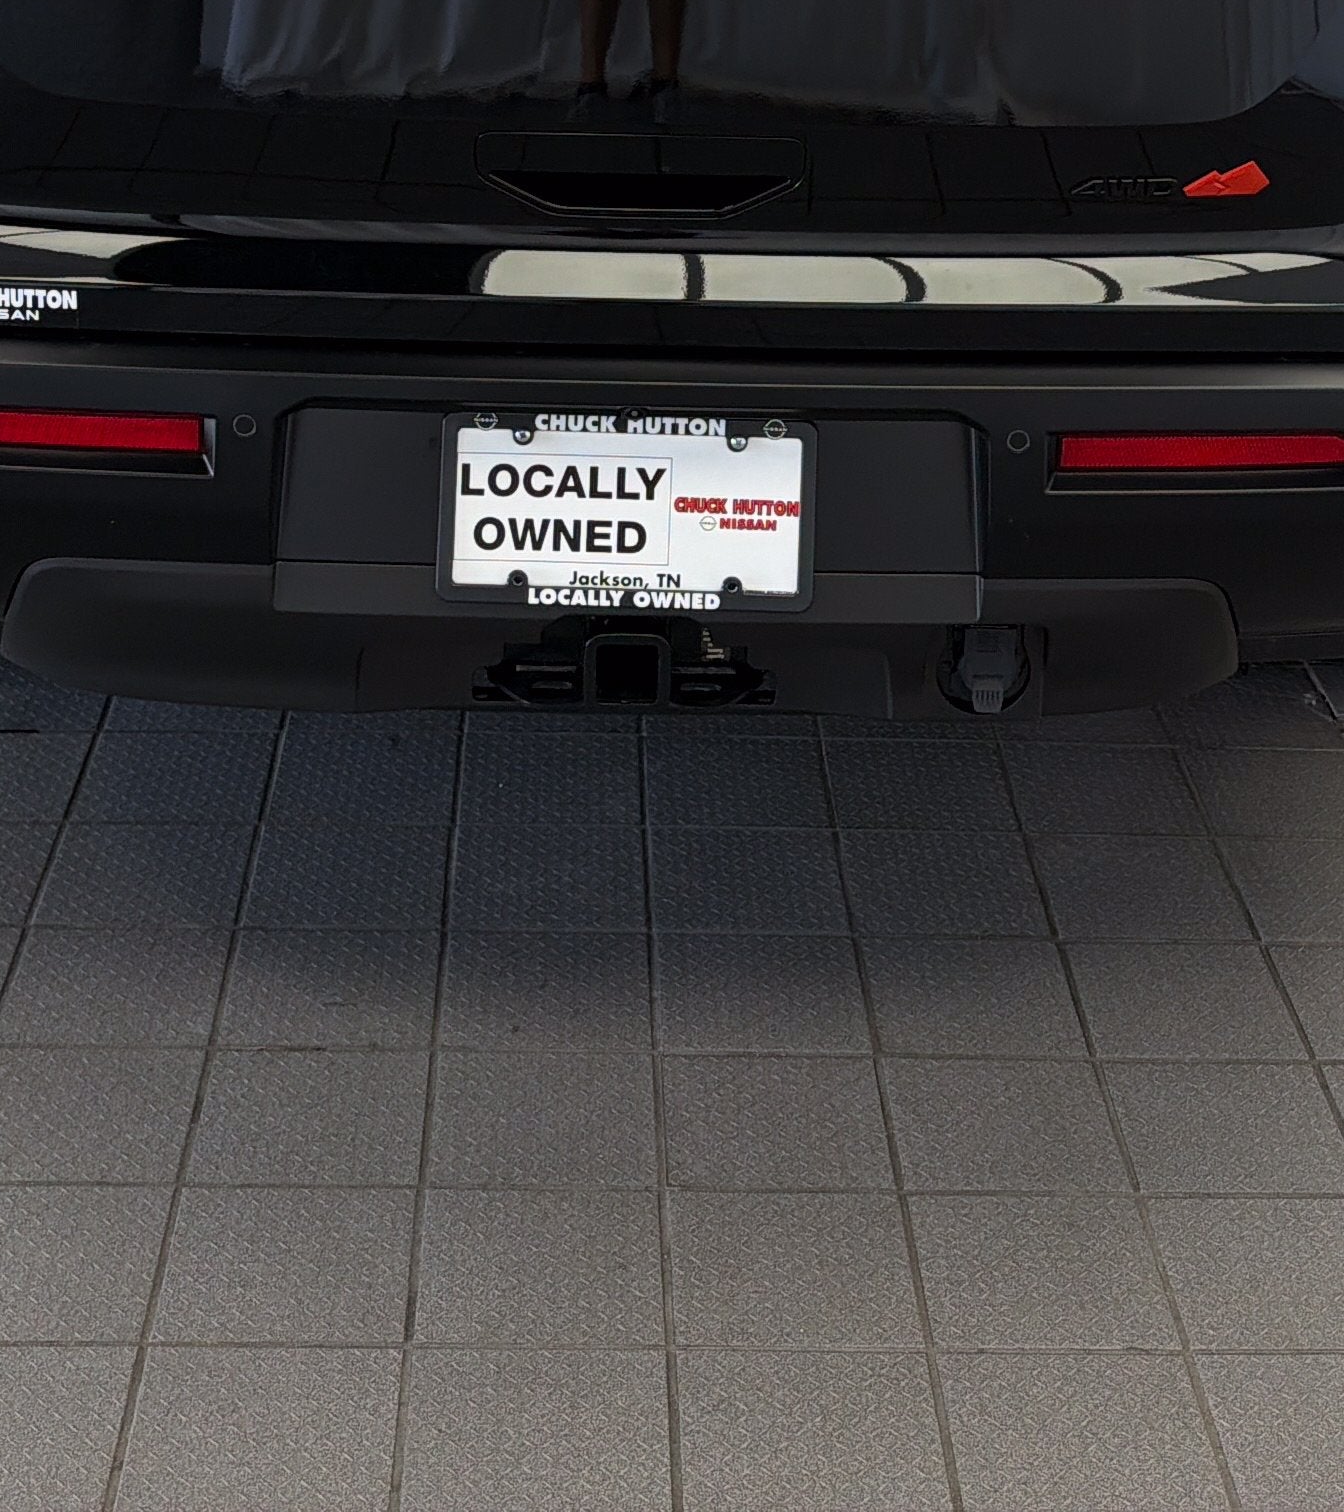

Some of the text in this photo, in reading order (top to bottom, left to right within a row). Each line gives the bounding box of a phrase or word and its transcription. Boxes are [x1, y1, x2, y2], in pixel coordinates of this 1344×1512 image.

[534, 413, 726, 437] CHUCK HUTTON
[460, 463, 666, 501] LOCALLY
[674, 496, 800, 518] CHUCK HUTTON
[473, 517, 647, 555] OWNED
[719, 517, 777, 532] NISSAN
[569, 570, 681, 590] Jackson, TN
[528, 587, 721, 611] LOCALLY OWNED
